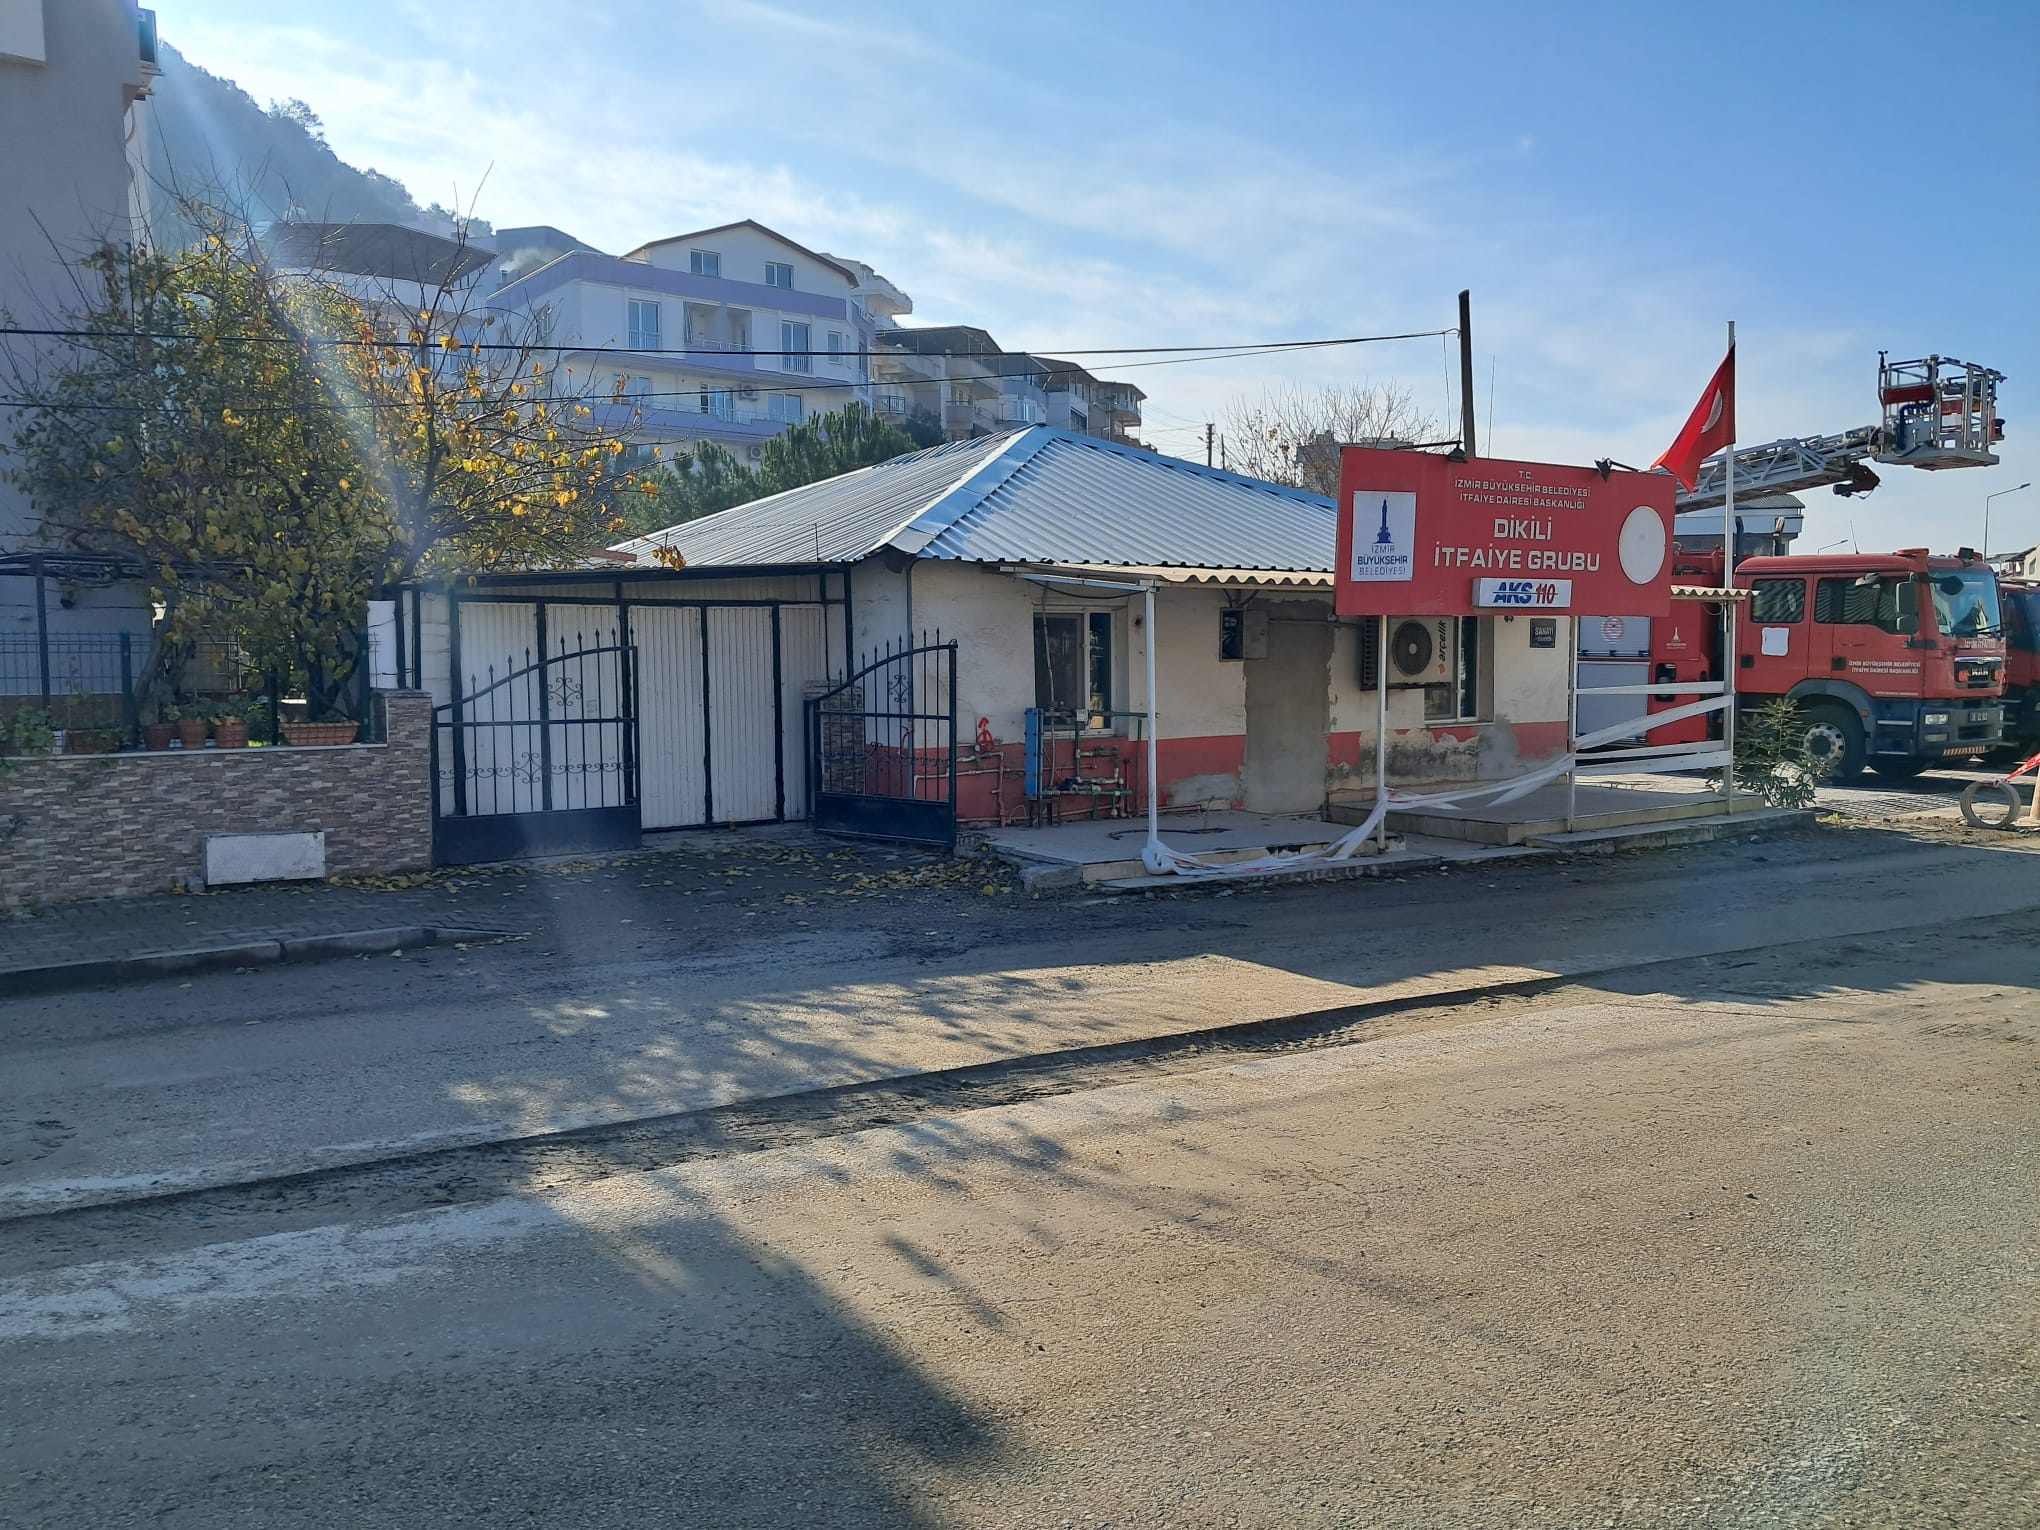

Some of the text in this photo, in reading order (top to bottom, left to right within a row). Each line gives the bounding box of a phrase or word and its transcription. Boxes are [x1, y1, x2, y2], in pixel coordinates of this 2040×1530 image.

[1519, 470, 1534, 480] T.C.
[1494, 514, 1552, 540] DİKİLİ
[1434, 541, 1600, 572] İTFAİYE GRUBU
[1493, 581, 1557, 605] AKS 110
[1437, 619, 1448, 662] arçelik
